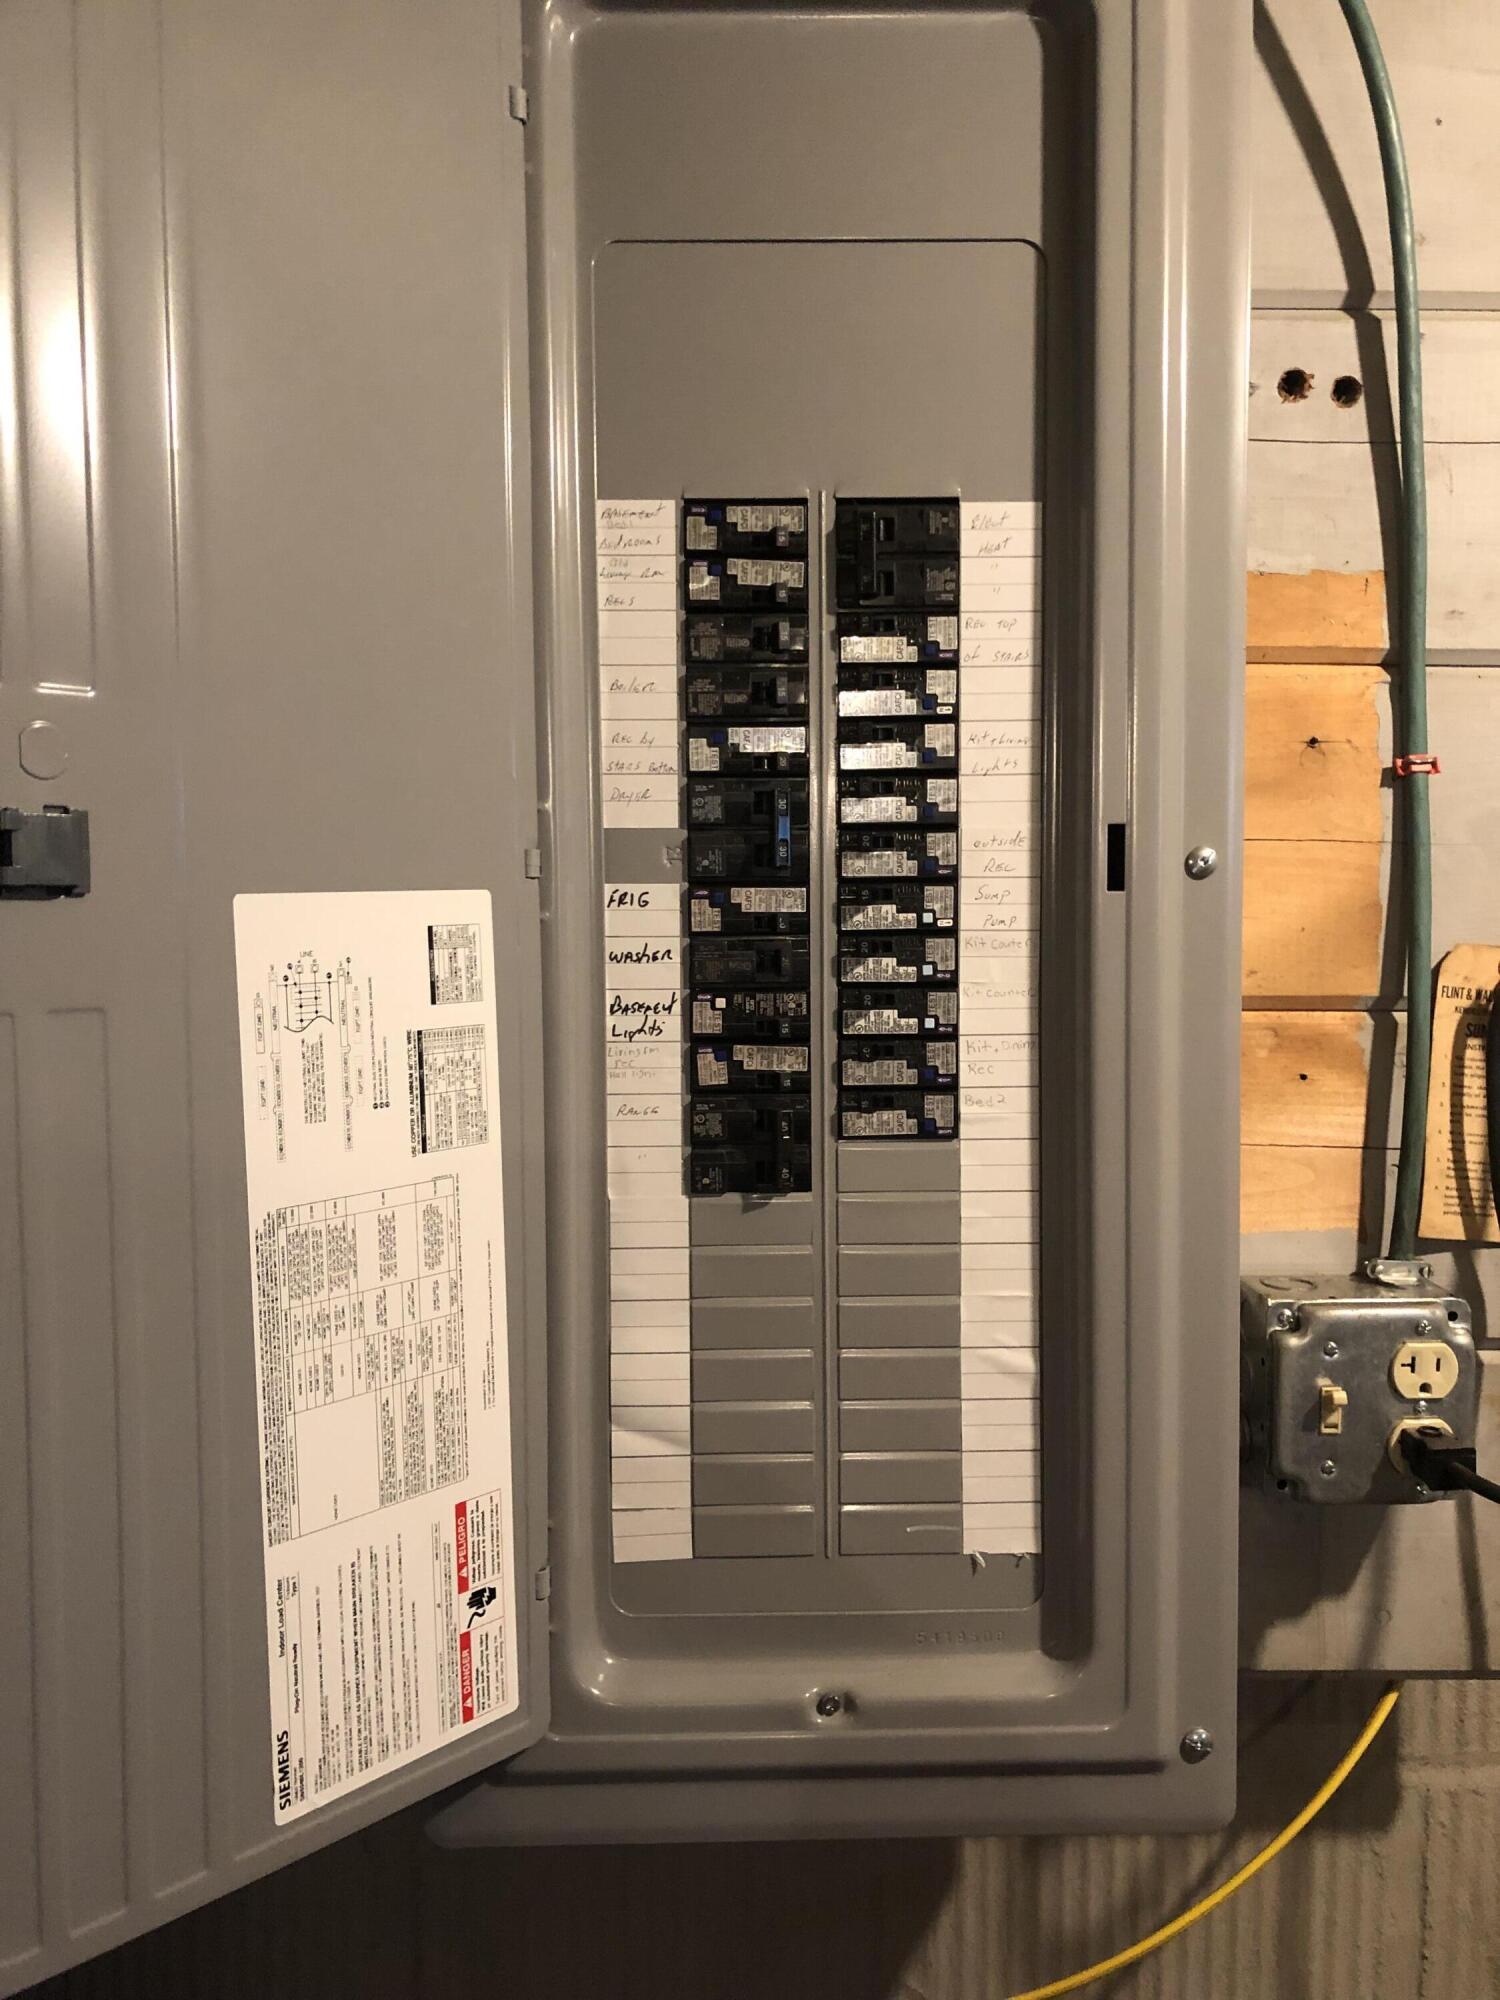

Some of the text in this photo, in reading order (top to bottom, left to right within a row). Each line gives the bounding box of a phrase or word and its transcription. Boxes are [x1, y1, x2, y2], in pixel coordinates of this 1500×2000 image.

[896, 638, 904, 660] CAFCI
[927, 671, 936, 691] TEST
[711, 749, 719, 770] TEST
[928, 781, 936, 803] TEST
[778, 799, 787, 809] 30
[779, 845, 787, 857] 30
[862, 835, 870, 847] 20
[928, 835, 936, 855] TEST
[607, 889, 650, 908] FRIG
[744, 890, 752, 911] CAFCI
[862, 889, 870, 900] 15
[925, 887, 933, 908] TEST
[861, 942, 868, 953] 20
[927, 940, 935, 960] TEST
[965, 936, 987, 948] Kit
[300, 950, 313, 958] LINE
[864, 994, 871, 1006] 20
[929, 992, 937, 1015] TEST
[1441, 985, 1493, 1003] FLINT & WA
[714, 1011, 722, 1033] TEST
[782, 1023, 789, 1034] 15
[746, 1047, 754, 1068] CAFCI
[926, 1096, 934, 1117] TEST
[965, 1094, 1006, 1107] Bed 2
[409, 1107, 415, 1116] OR
[896, 1113, 904, 1132] CAFCI
[781, 1168, 790, 1179] 40
[457, 1516, 467, 1564] PELIGRO
[276, 1579, 284, 1606] Center
[278, 1631, 286, 1658] Indoor
[461, 1648, 471, 1694] DANGER
[276, 1730, 291, 1811] SIEMENS
